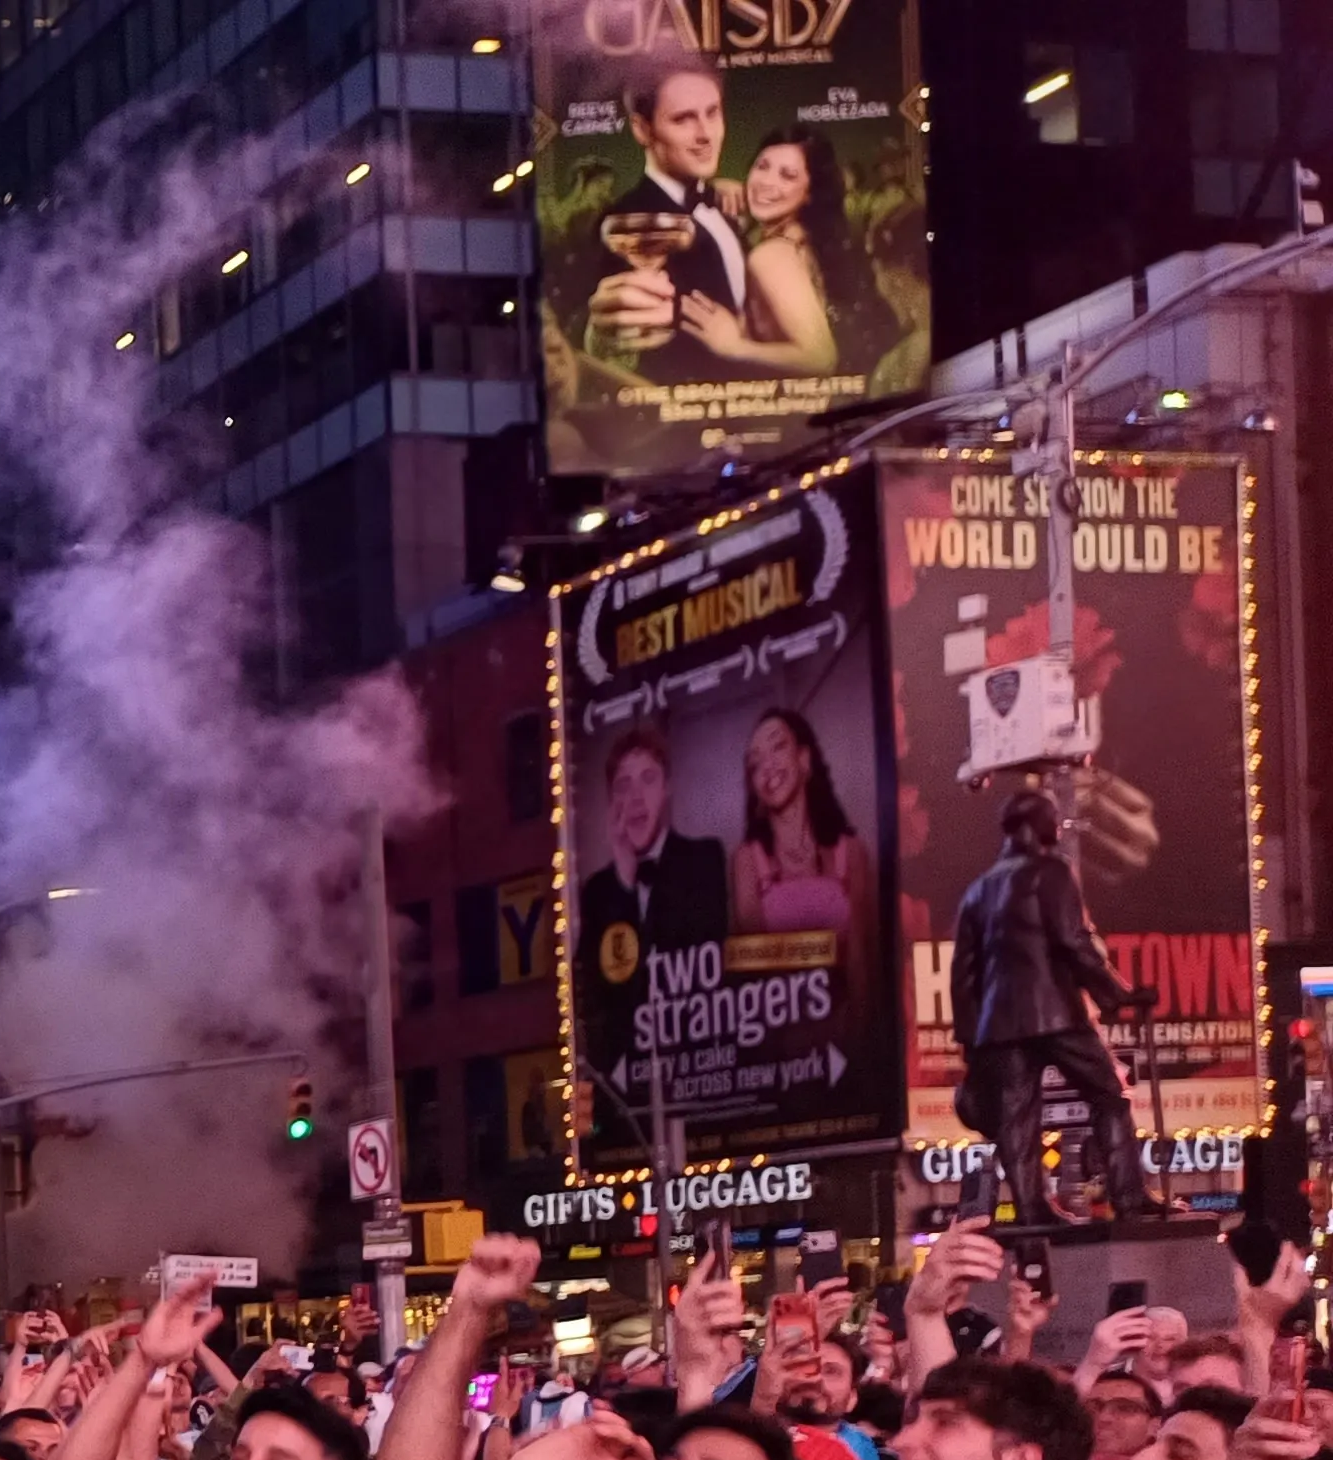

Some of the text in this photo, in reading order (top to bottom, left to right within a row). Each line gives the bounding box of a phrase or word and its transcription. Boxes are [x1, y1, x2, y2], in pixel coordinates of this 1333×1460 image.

[950, 475, 1017, 517] COME
[1023, 476, 1050, 517] SE
[1133, 477, 1179, 518] THE
[904, 518, 1224, 574] WORLD OULD BE
[615, 602, 679, 669] BEST
[682, 558, 804, 644] MUSICAL
[645, 939, 722, 996] two
[913, 933, 1252, 1025] HTOWN
[633, 967, 832, 1050] strangers
[693, 1043, 737, 1071] cake
[737, 1061, 776, 1087] new
[780, 1047, 824, 1091] york
[523, 1162, 813, 1228] GIFTS LUGGAGE
